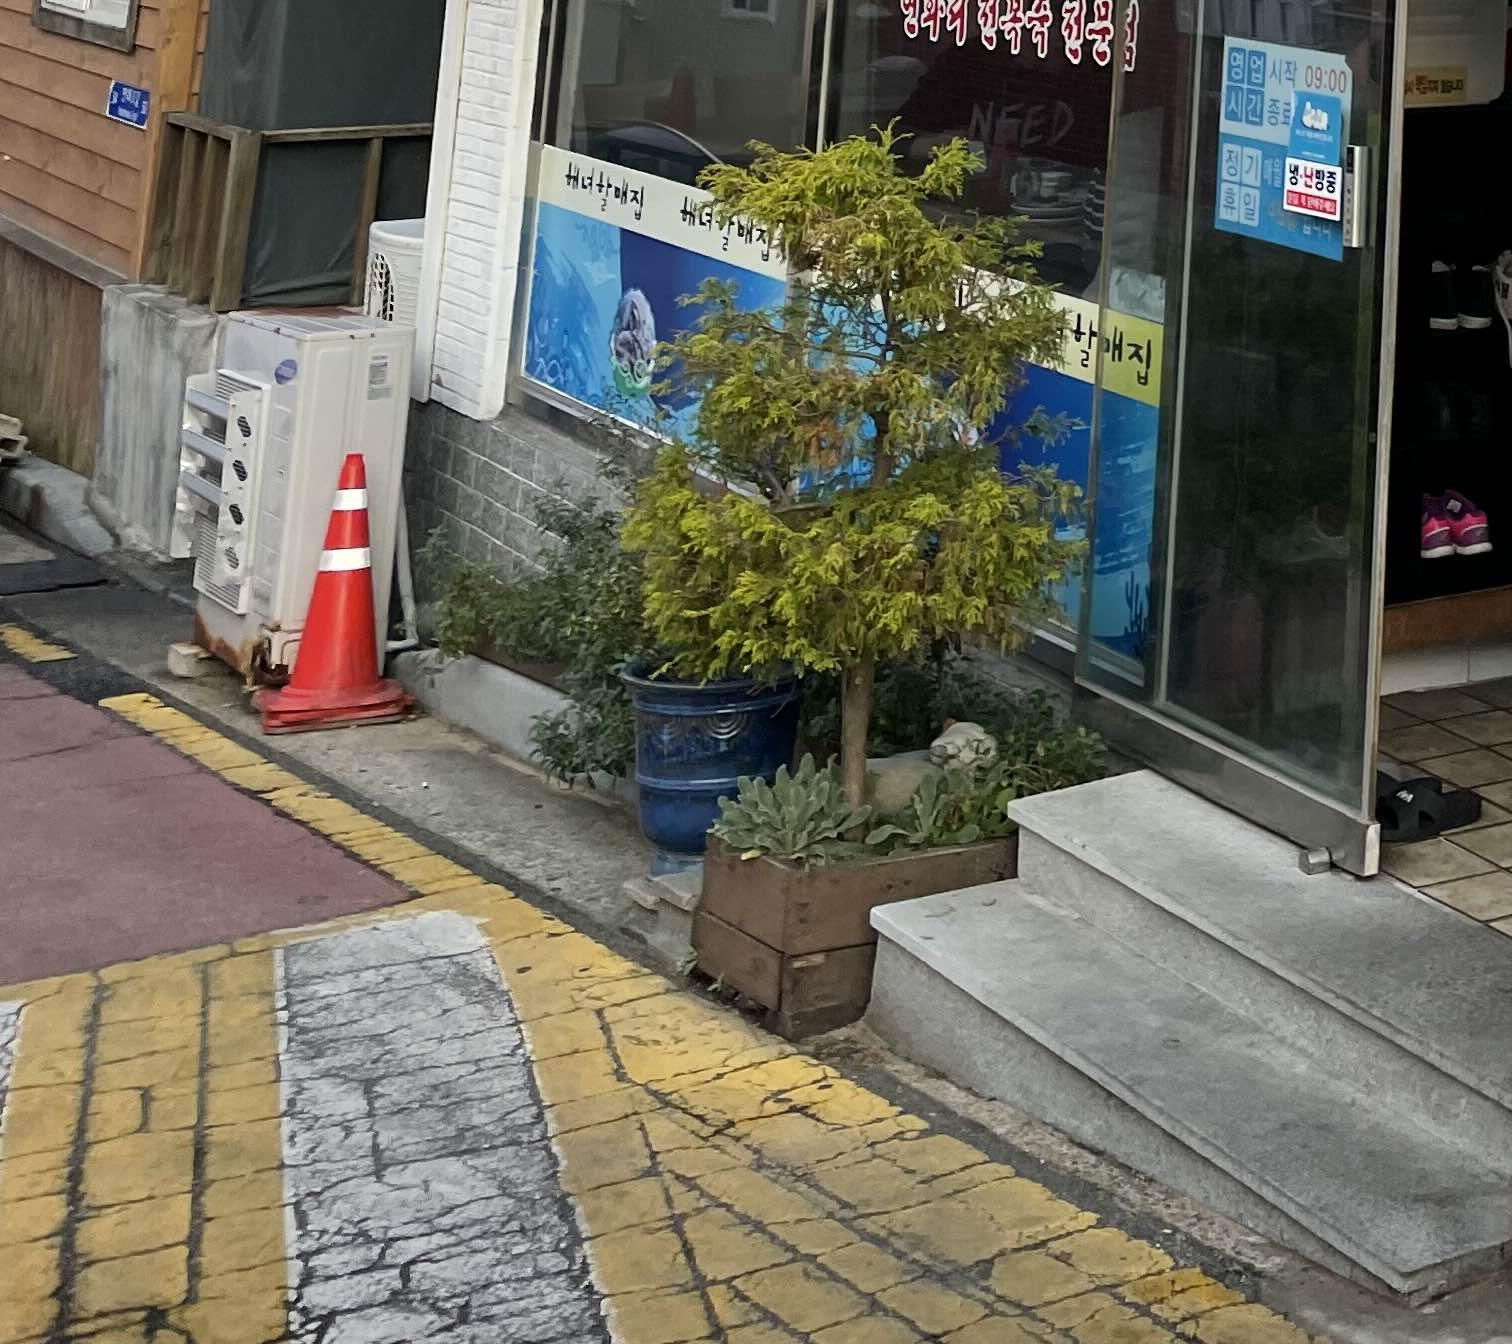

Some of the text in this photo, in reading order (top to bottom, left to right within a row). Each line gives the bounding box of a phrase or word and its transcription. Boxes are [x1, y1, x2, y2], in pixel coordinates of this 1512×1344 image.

[1230, 51, 1347, 94] 영업 시작 09:00
[1228, 91, 1262, 122] 시간
[1225, 149, 1260, 184] 정기
[565, 161, 644, 221] 해녀할매집
[1223, 188, 1257, 222] 휴일
[1058, 313, 1152, 386] 할매집
